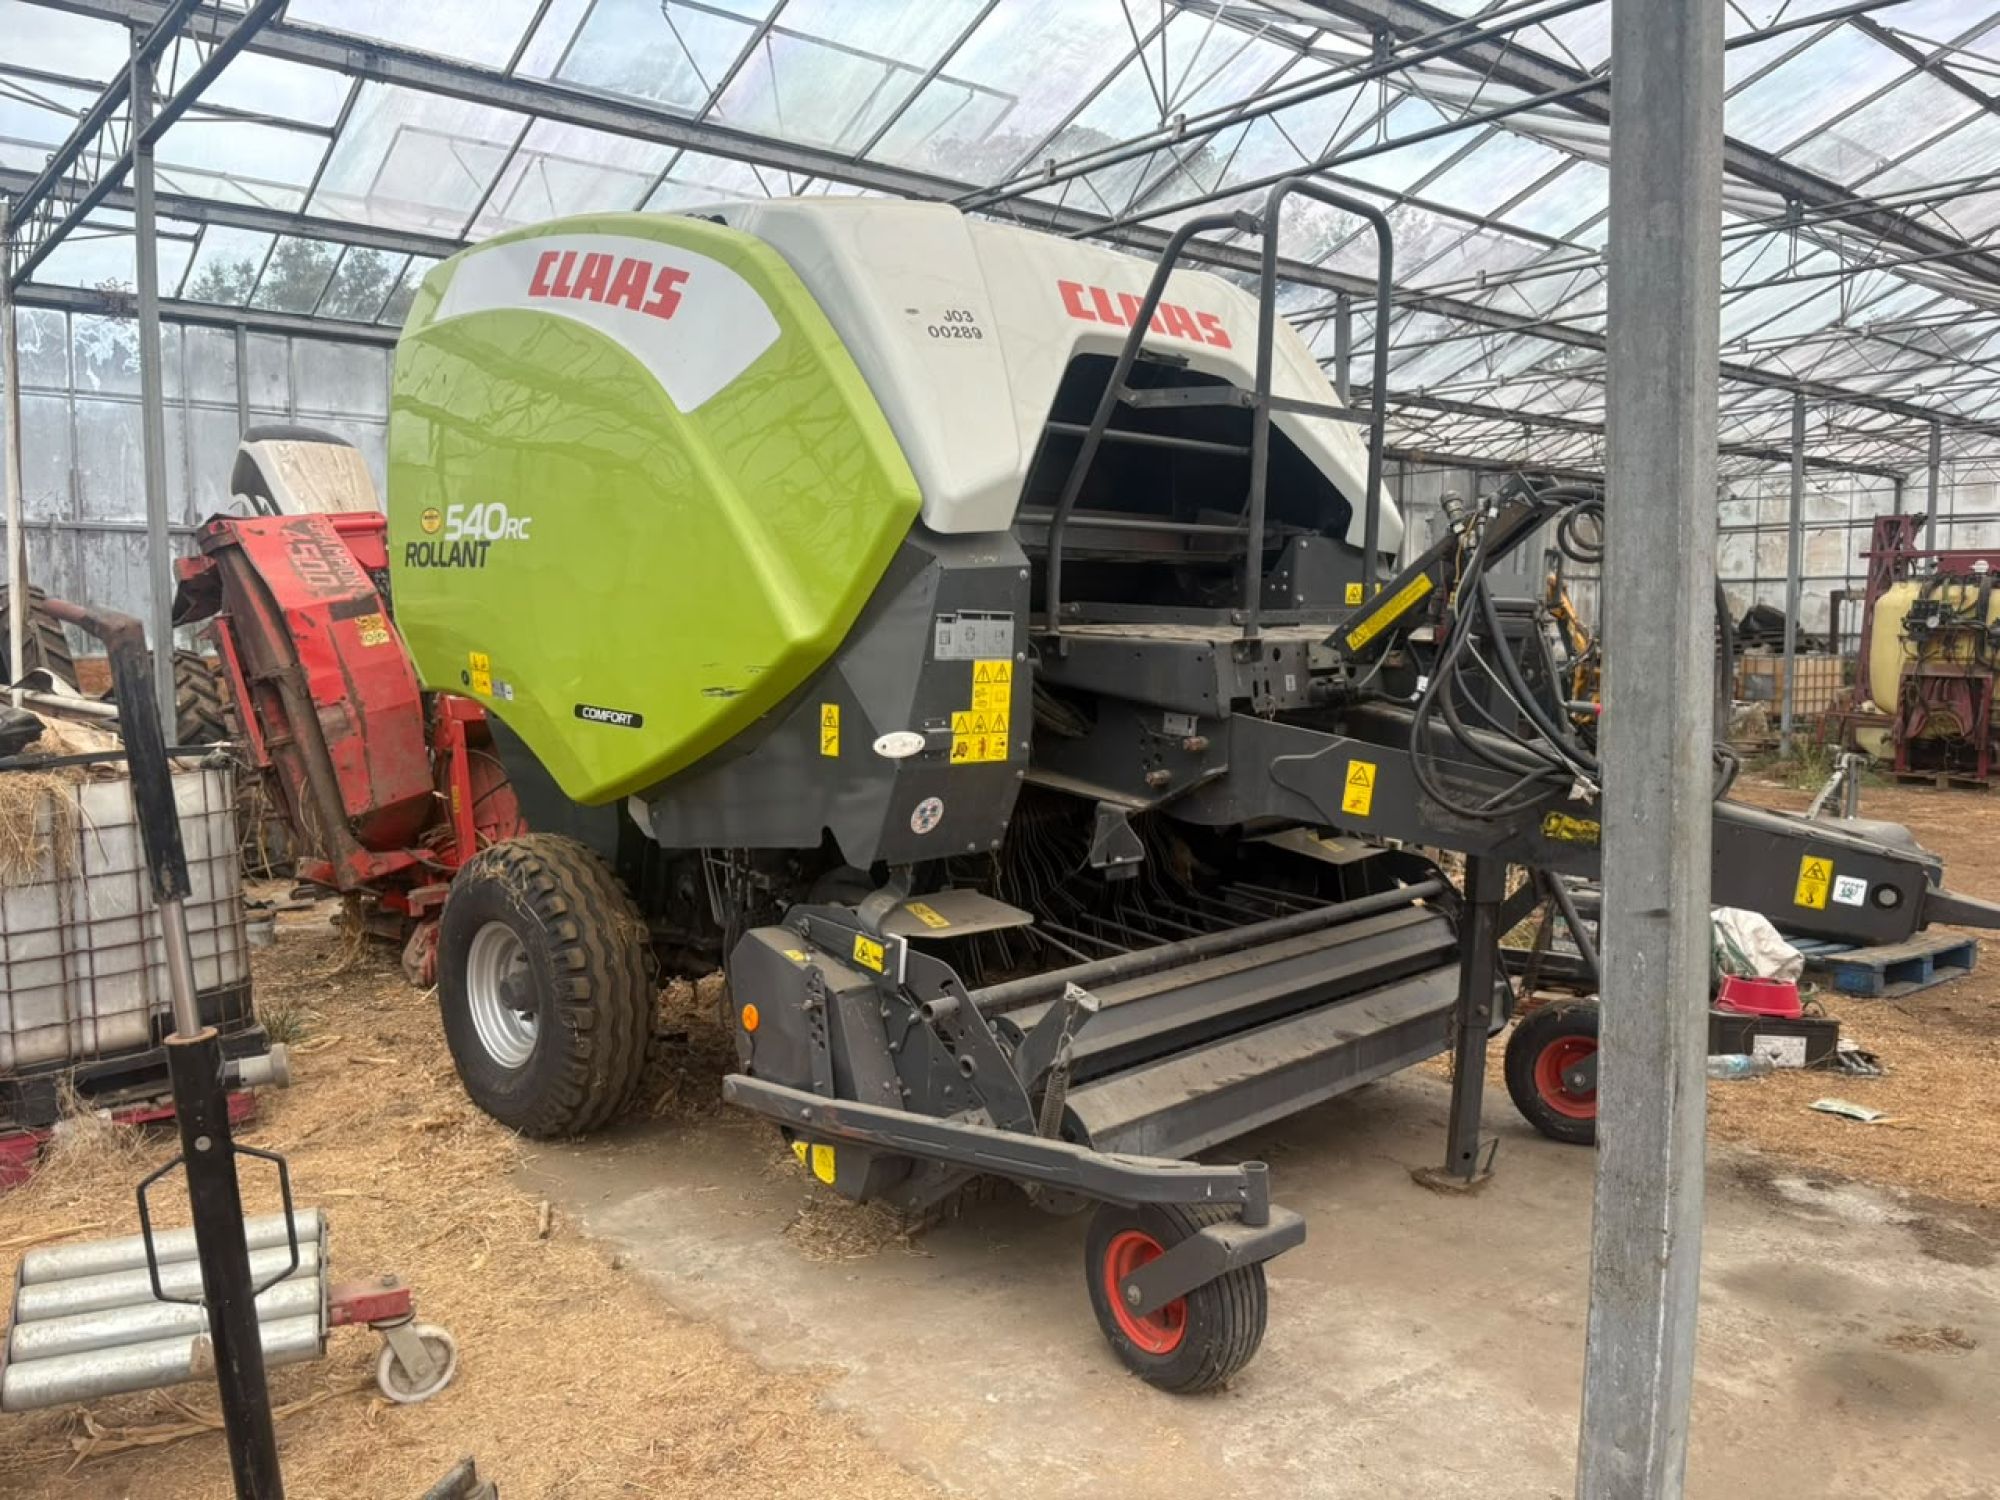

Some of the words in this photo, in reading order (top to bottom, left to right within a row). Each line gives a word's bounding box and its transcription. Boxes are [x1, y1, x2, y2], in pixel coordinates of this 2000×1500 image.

[528, 251, 690, 320] CLAAS
[944, 309, 974, 322] J03
[1058, 280, 1232, 349] CLAAS
[928, 325, 983, 339] 00289
[405, 540, 491, 568] ROLLANT
[582, 707, 634, 725] COMFORT
